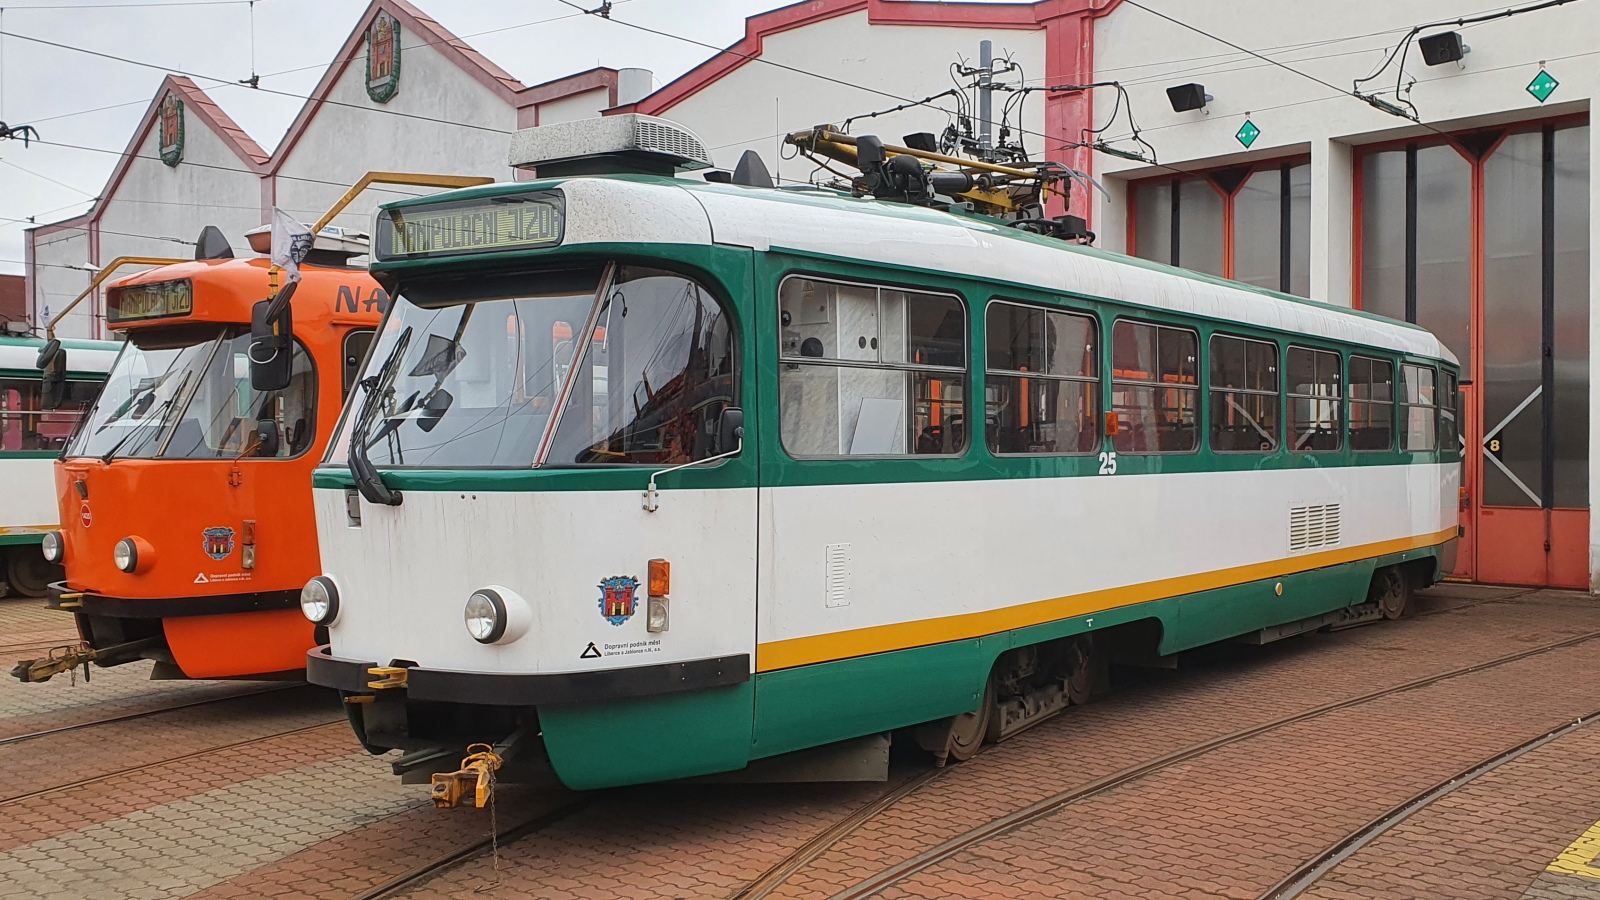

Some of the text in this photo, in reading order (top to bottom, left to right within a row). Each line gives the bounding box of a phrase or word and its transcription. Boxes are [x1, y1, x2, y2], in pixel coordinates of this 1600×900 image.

[1490, 439, 1500, 452] 8
[1098, 451, 1117, 475] 25
[630, 641, 647, 649] podnik
